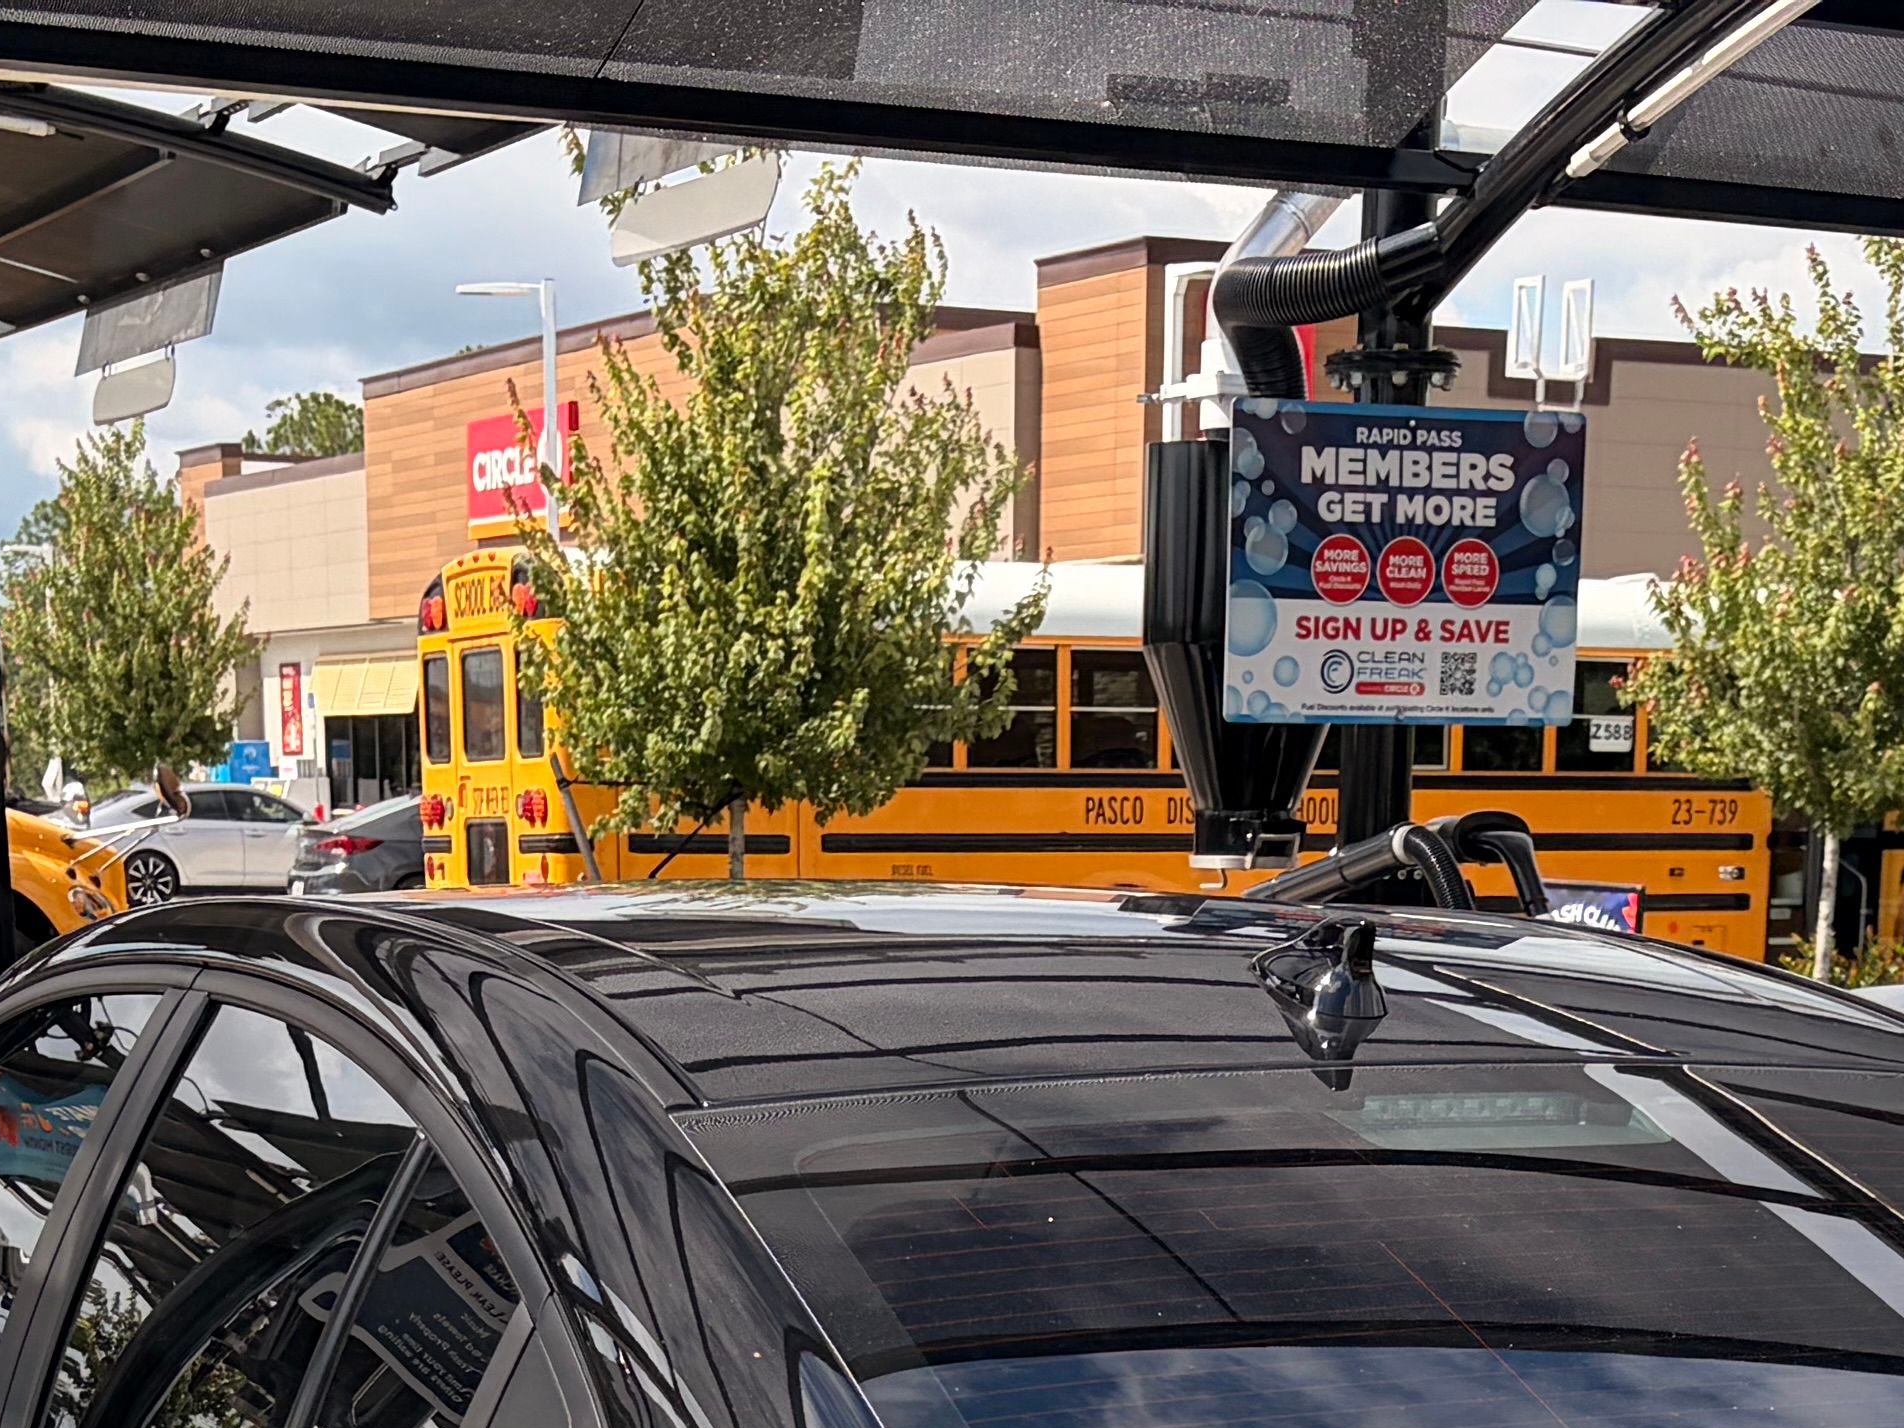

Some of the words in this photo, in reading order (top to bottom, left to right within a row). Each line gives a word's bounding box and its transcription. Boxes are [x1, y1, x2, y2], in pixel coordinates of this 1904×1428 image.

[1356, 426, 1412, 446] RAPID
[1416, 429, 1463, 448] PASS
[473, 446, 536, 493] CIRCLE
[1300, 445, 1516, 492] MEMBERS
[1317, 490, 1389, 524] GET
[1396, 494, 1497, 527] MORE
[1323, 549, 1360, 562] MORE
[1389, 555, 1425, 567] MORE
[1454, 552, 1489, 565] MORE
[1315, 561, 1368, 574] SAVINGS
[1386, 567, 1427, 580] CLEAN
[1451, 564, 1490, 577] SPEED
[1295, 616, 1362, 641] SIGN
[1370, 617, 1408, 642] UP
[1414, 618, 1432, 643] &
[1439, 619, 1511, 644] SAVE
[1356, 650, 1426, 664] CLEAN
[1356, 666, 1426, 680] FREAK
[1085, 796, 1144, 825] PASCO
[1671, 798, 1738, 825] 23-739
